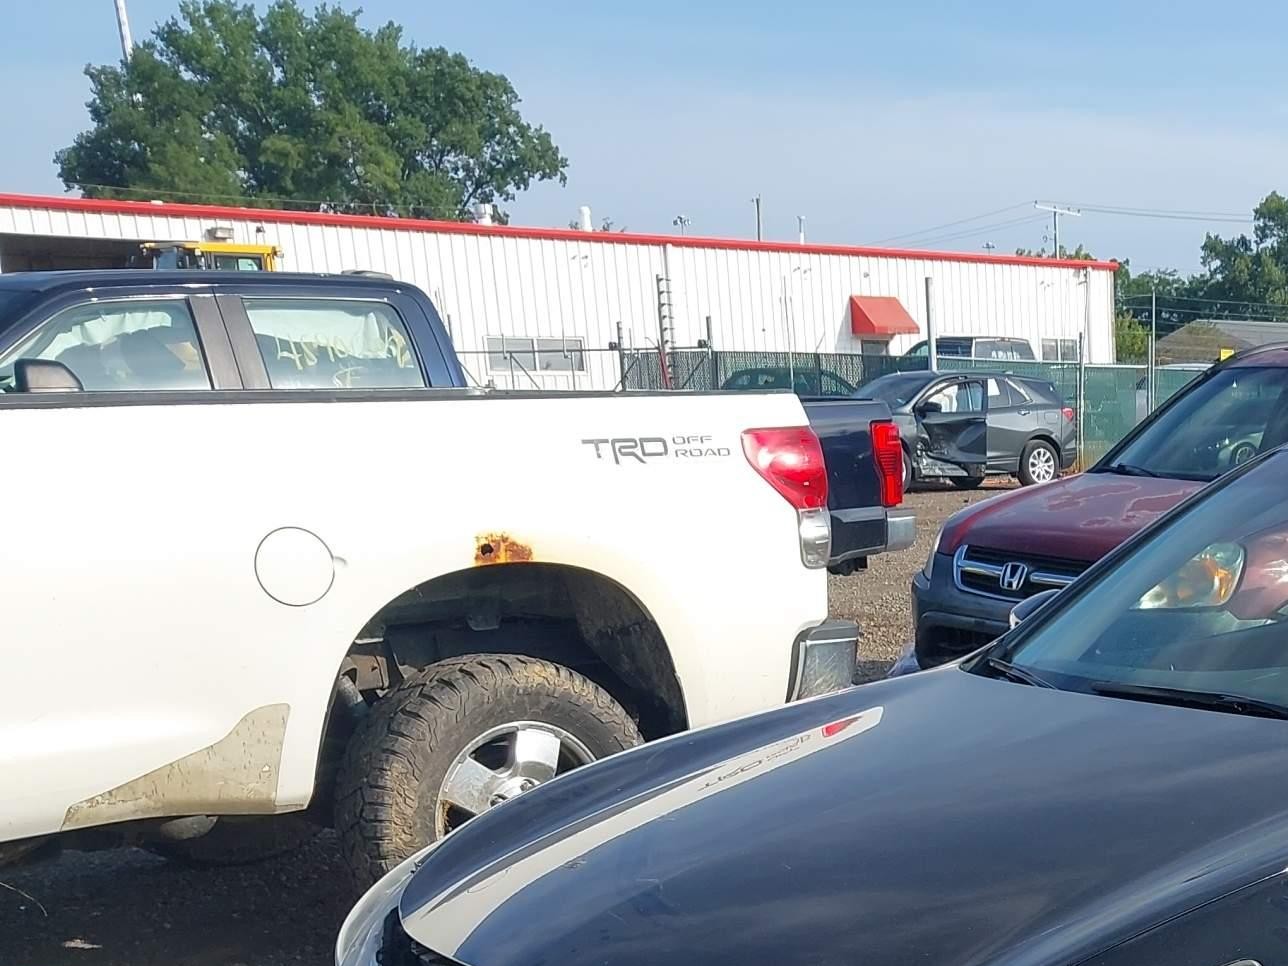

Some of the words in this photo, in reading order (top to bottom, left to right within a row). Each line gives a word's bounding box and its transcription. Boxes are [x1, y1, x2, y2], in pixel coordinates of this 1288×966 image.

[672, 436, 712, 445] OFF
[581, 437, 668, 464] TRD
[674, 447, 731, 458] ROAD
